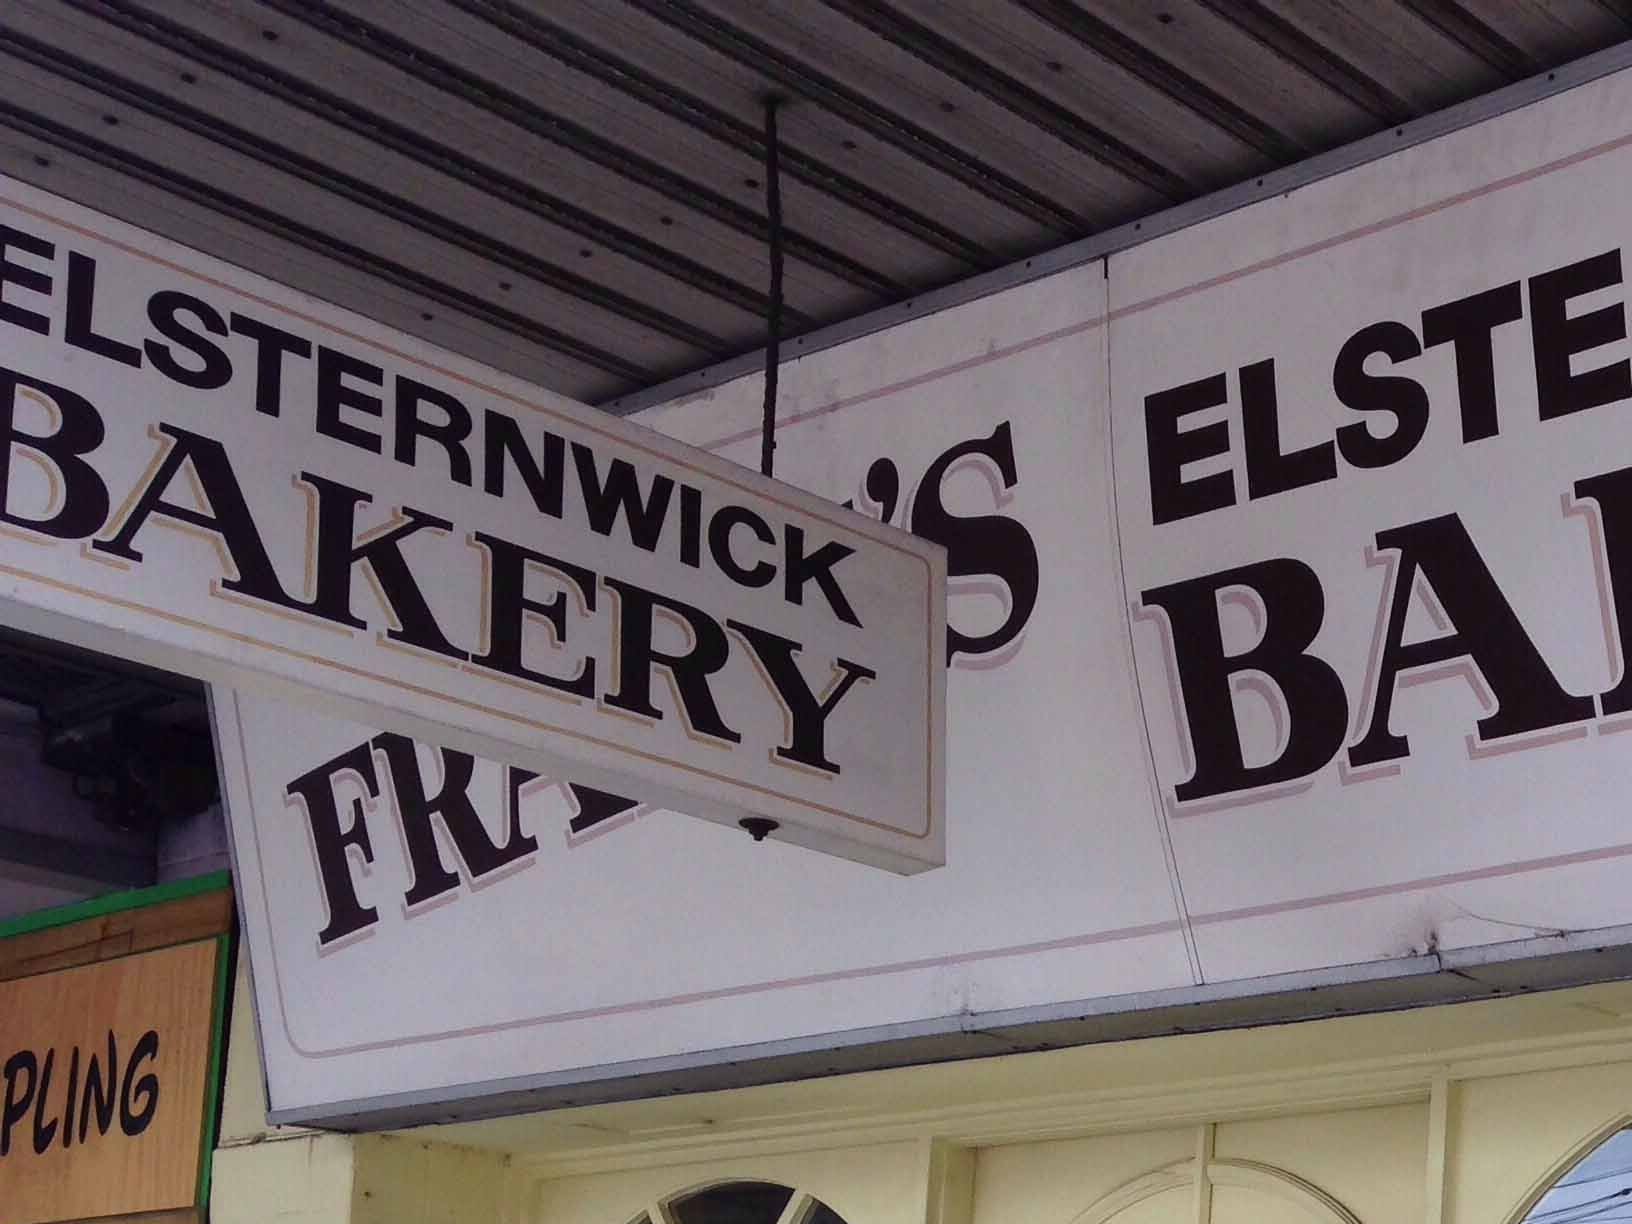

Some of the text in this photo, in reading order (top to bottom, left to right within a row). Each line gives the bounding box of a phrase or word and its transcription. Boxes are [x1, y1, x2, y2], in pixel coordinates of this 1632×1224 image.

[0, 226, 864, 628] ELSTERNWICK
[0, 369, 876, 776] BAKERY
[1, 1029, 159, 1156] PLING
